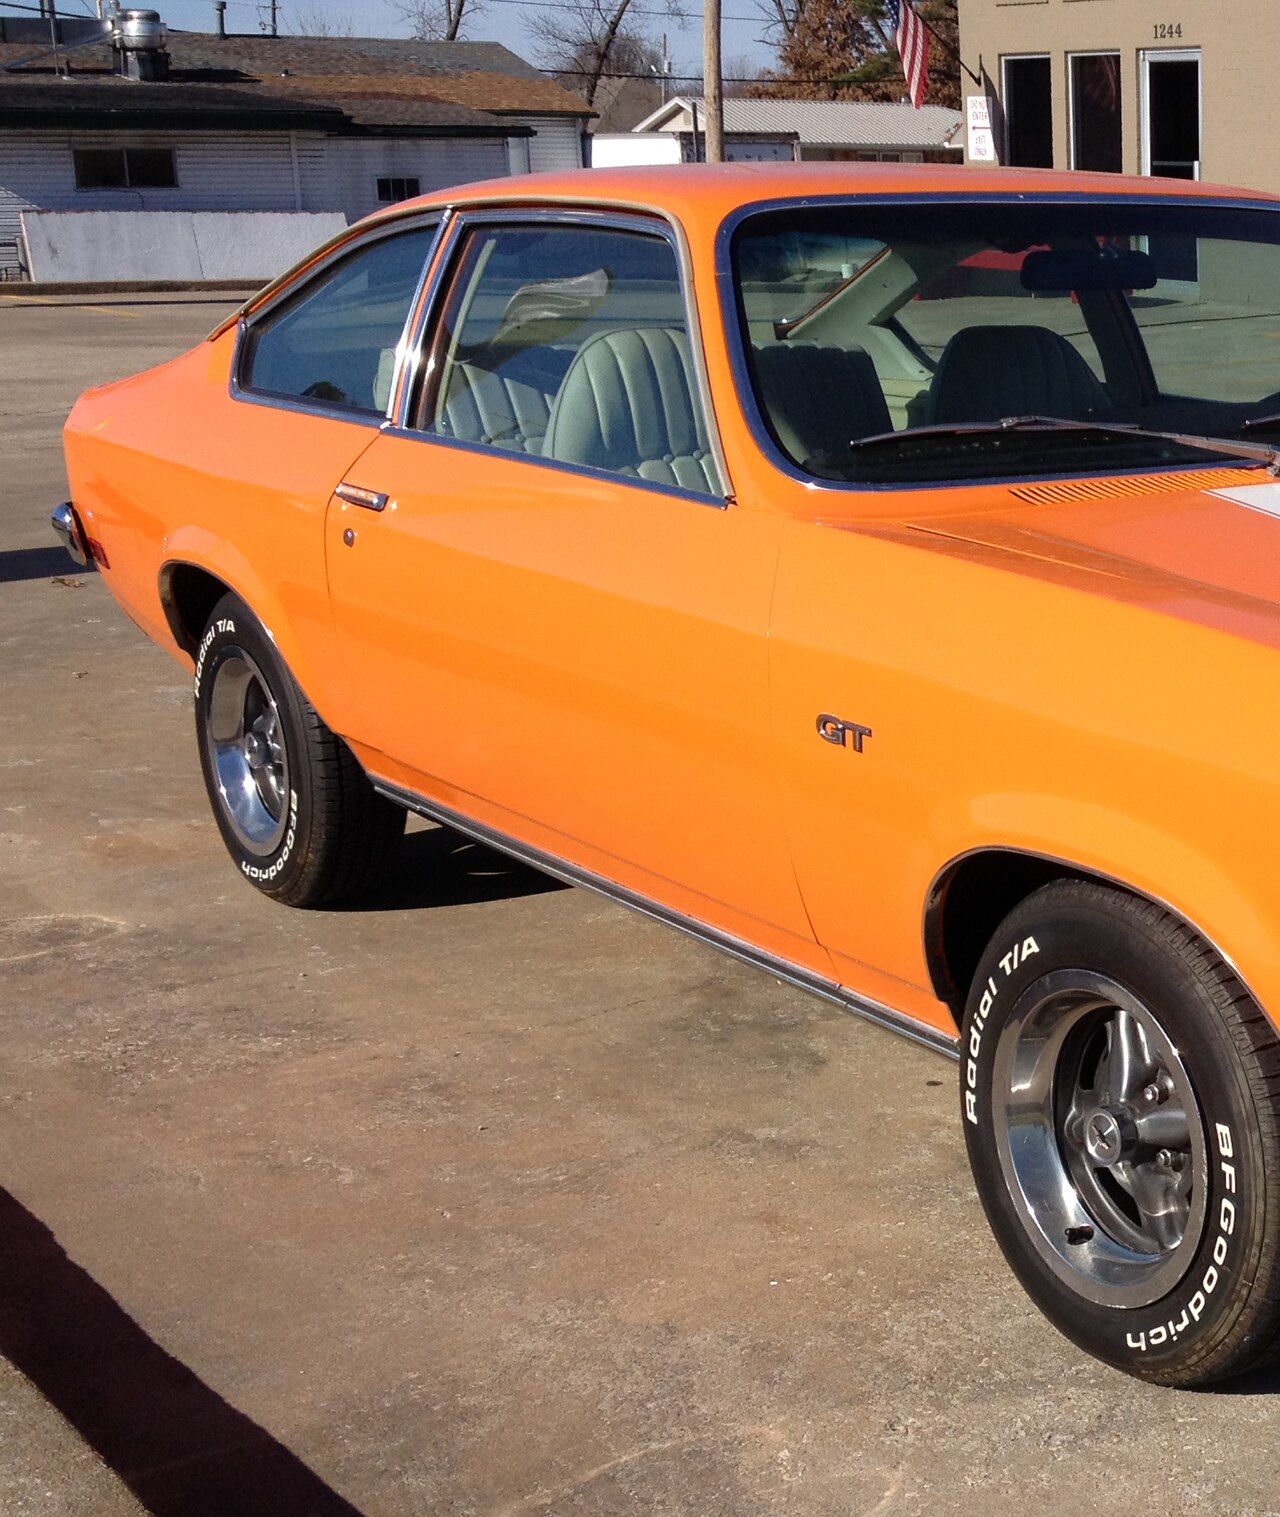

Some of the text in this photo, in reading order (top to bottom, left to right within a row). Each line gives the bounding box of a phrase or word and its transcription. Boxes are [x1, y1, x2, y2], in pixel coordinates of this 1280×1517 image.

[1153, 23, 1182, 39] 1244
[194, 618, 236, 698] Radial T/A
[815, 712, 872, 753] GT
[241, 788, 299, 882] BFGoodrich
[965, 936, 1040, 1125] Radial T/A
[1125, 1121, 1238, 1352] BFGoodrich
